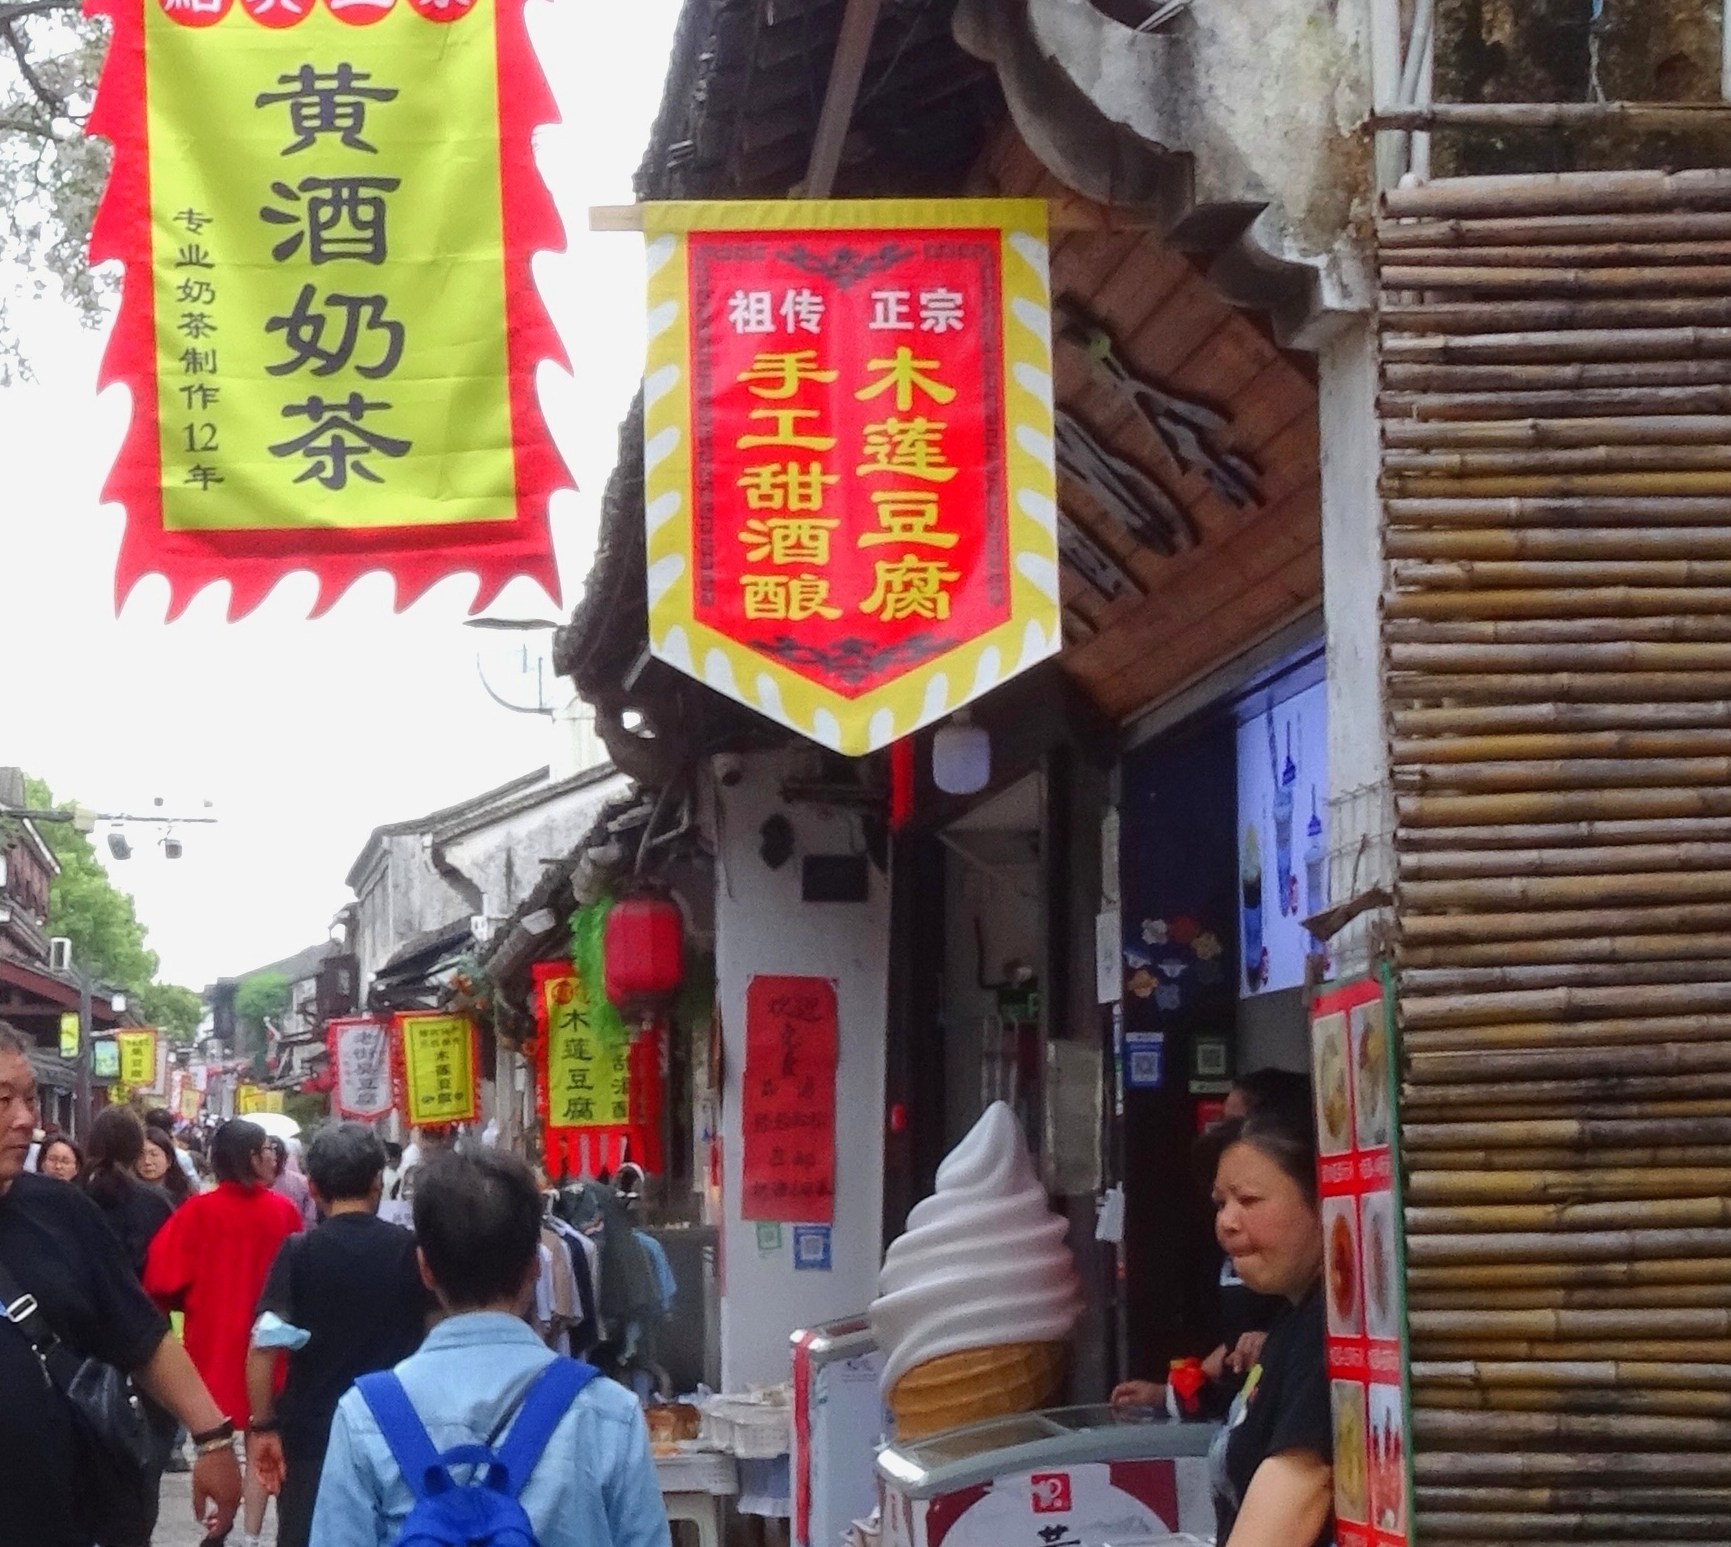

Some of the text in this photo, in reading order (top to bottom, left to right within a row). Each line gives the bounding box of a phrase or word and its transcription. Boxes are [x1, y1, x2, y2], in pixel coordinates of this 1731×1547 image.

[172, 207, 224, 491] 专业奶茶制作12年
[255, 62, 413, 491] 黄酒奶茶
[727, 290, 826, 334] 祖传
[868, 288, 965, 332] 正宗
[735, 349, 843, 622] 手工甜酒酿
[855, 346, 961, 622] 木莲豆腐
